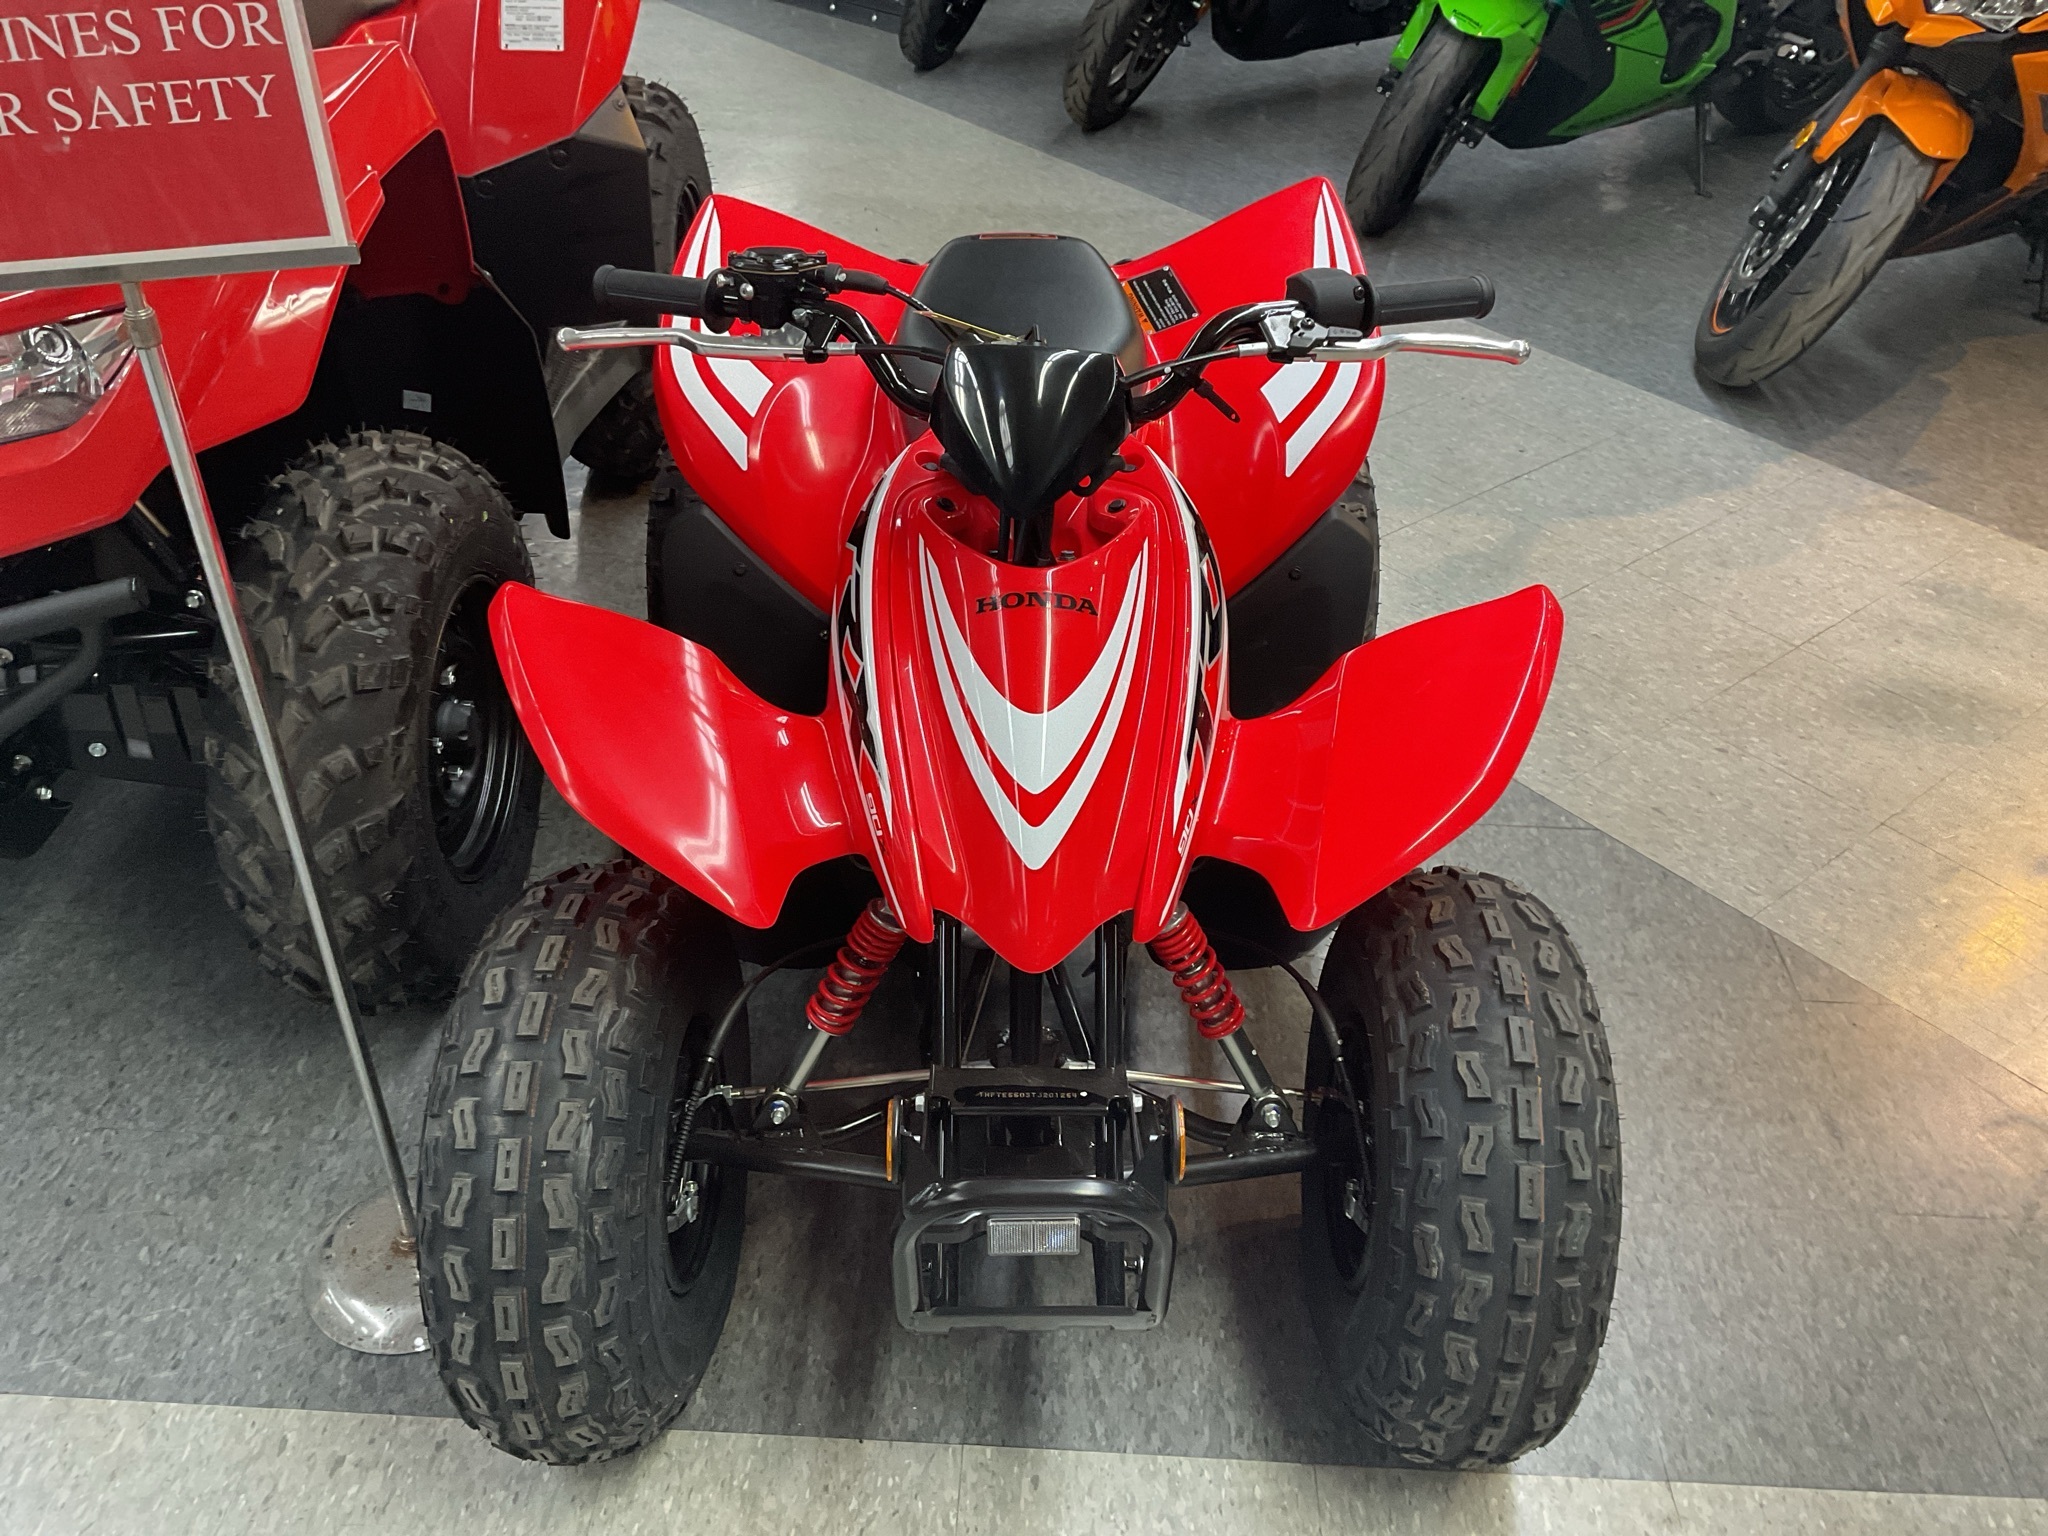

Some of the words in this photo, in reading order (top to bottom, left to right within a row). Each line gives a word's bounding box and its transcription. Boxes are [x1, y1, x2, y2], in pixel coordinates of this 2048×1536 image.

[0, 9, 141, 63] INES
[152, 2, 284, 52] FOR
[47, 74, 276, 133] SAFETY
[976, 591, 1099, 617] HONDA
